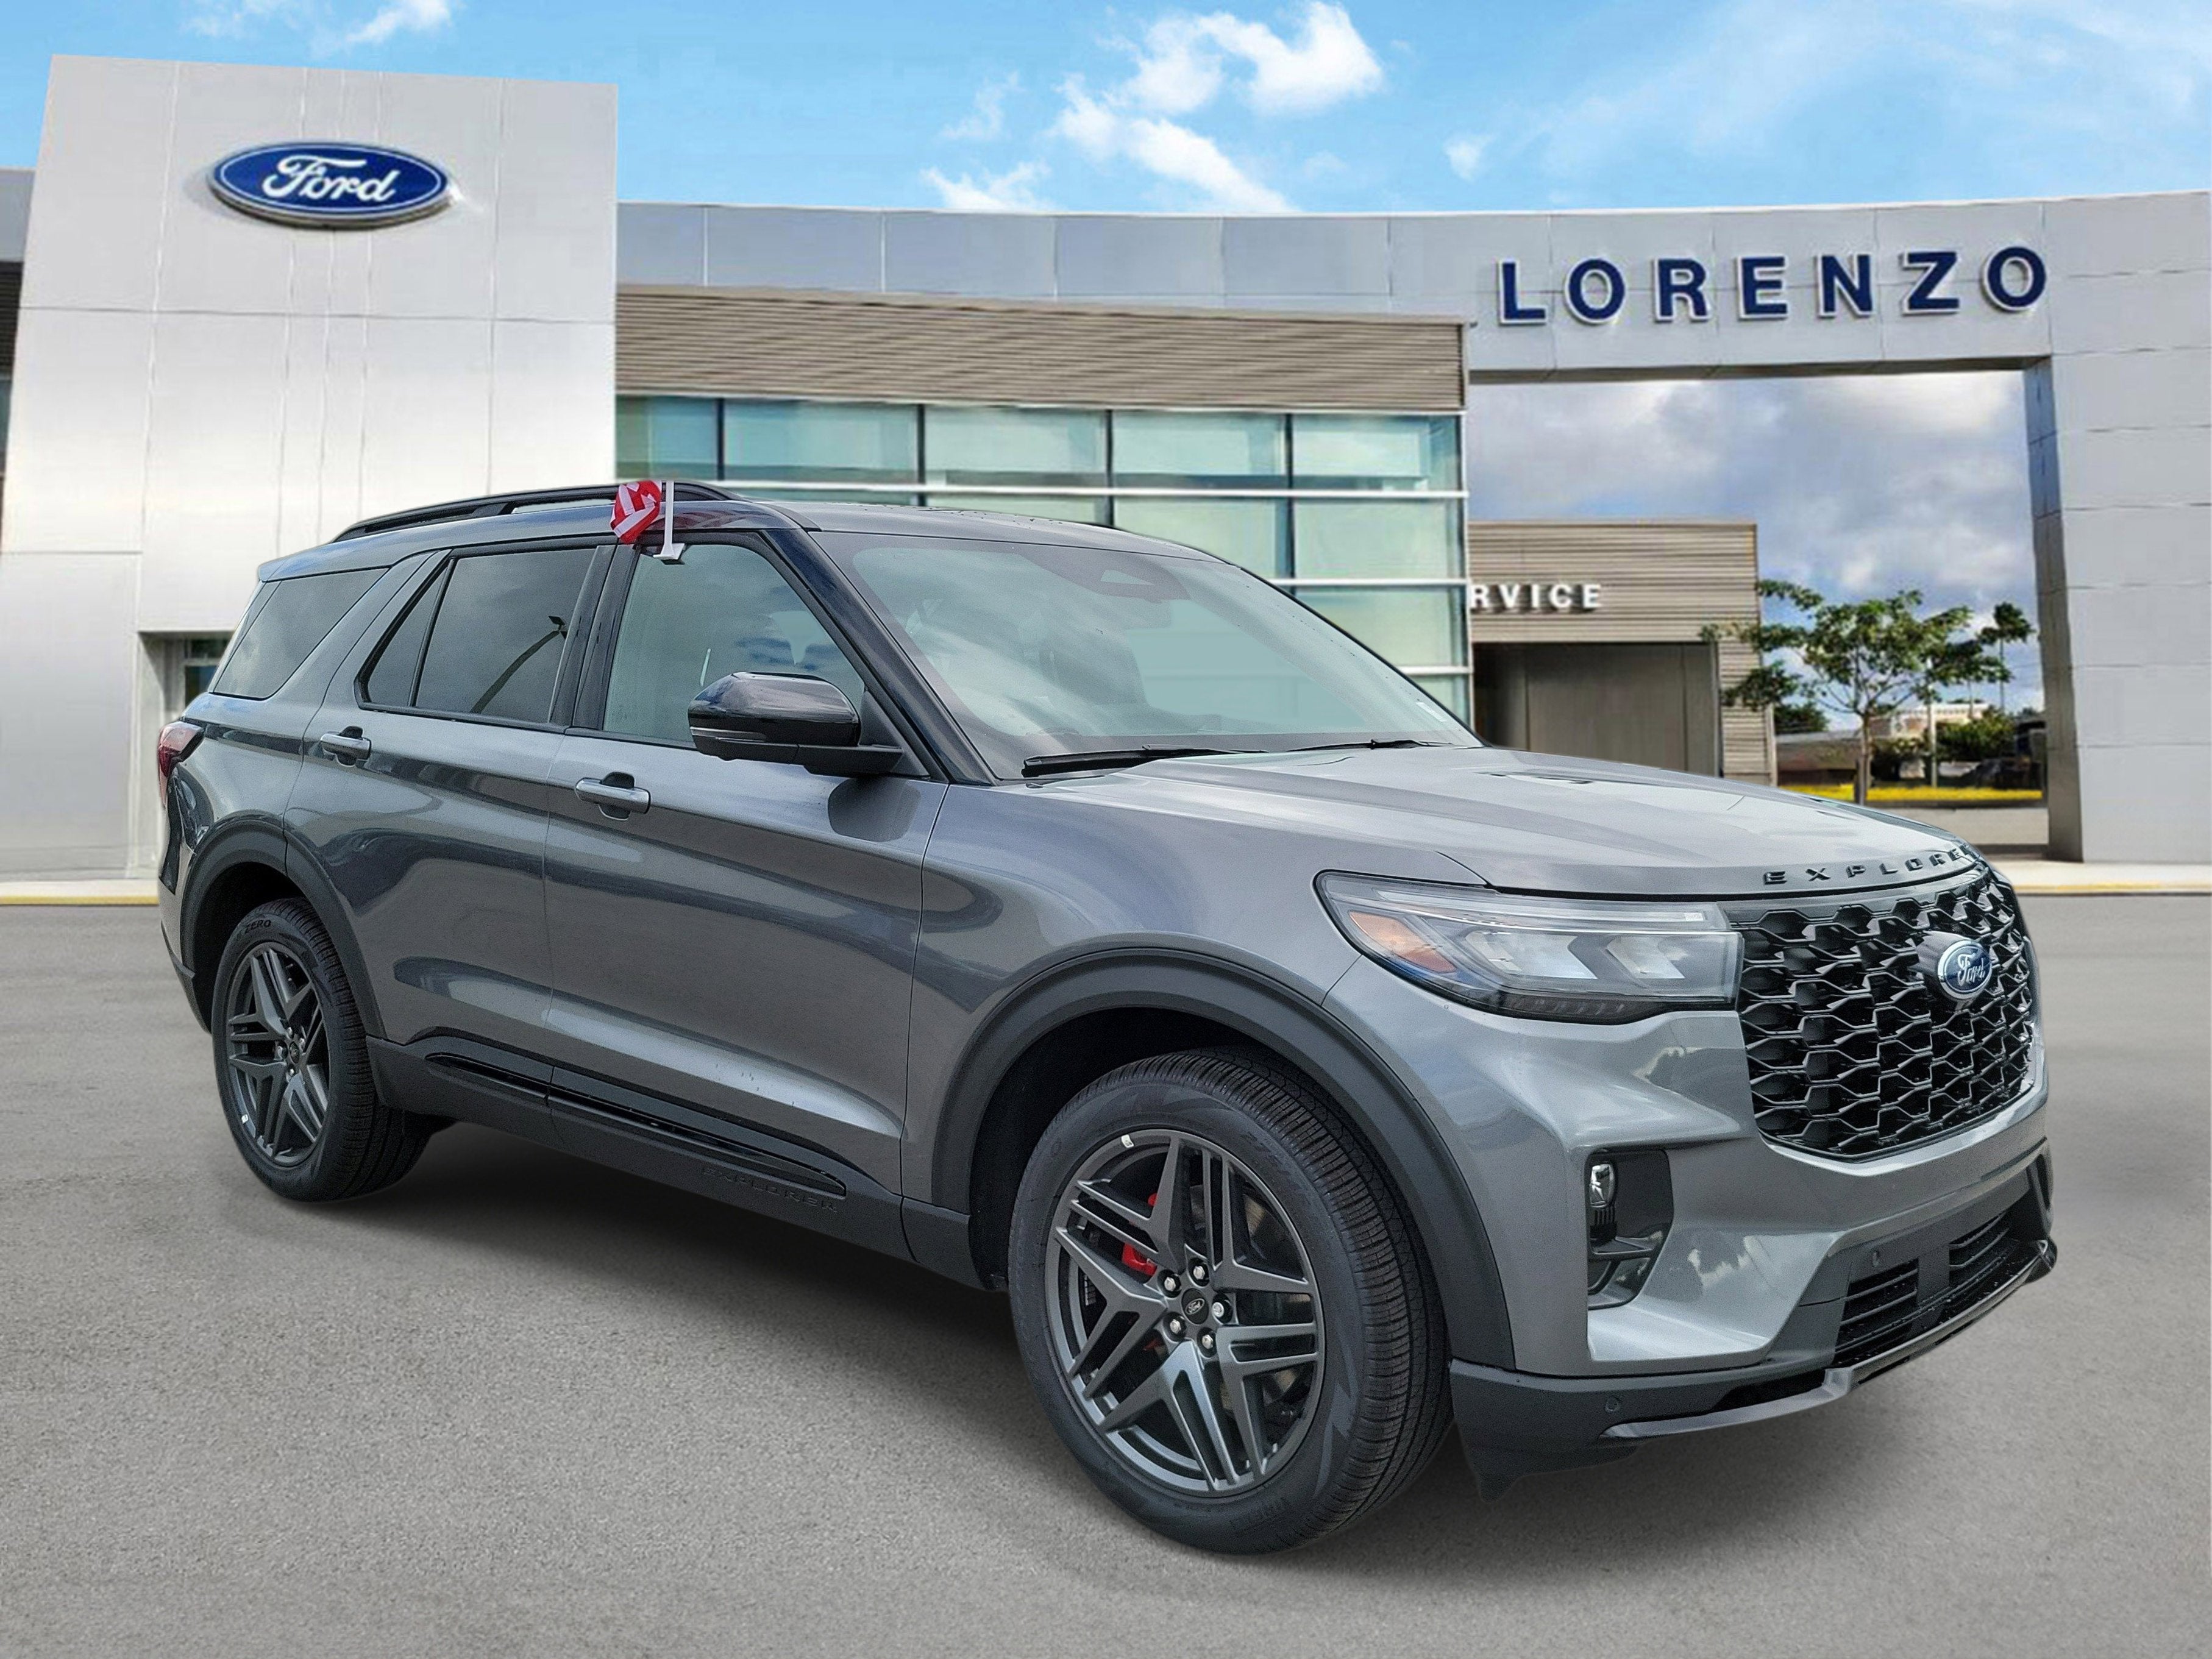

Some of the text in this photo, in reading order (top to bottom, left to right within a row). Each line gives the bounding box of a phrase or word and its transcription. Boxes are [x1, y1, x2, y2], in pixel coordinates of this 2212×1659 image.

[262, 155, 400, 202] Ford
[1499, 246, 2047, 325] LORENZO
[1957, 953, 1986, 986] Ford
